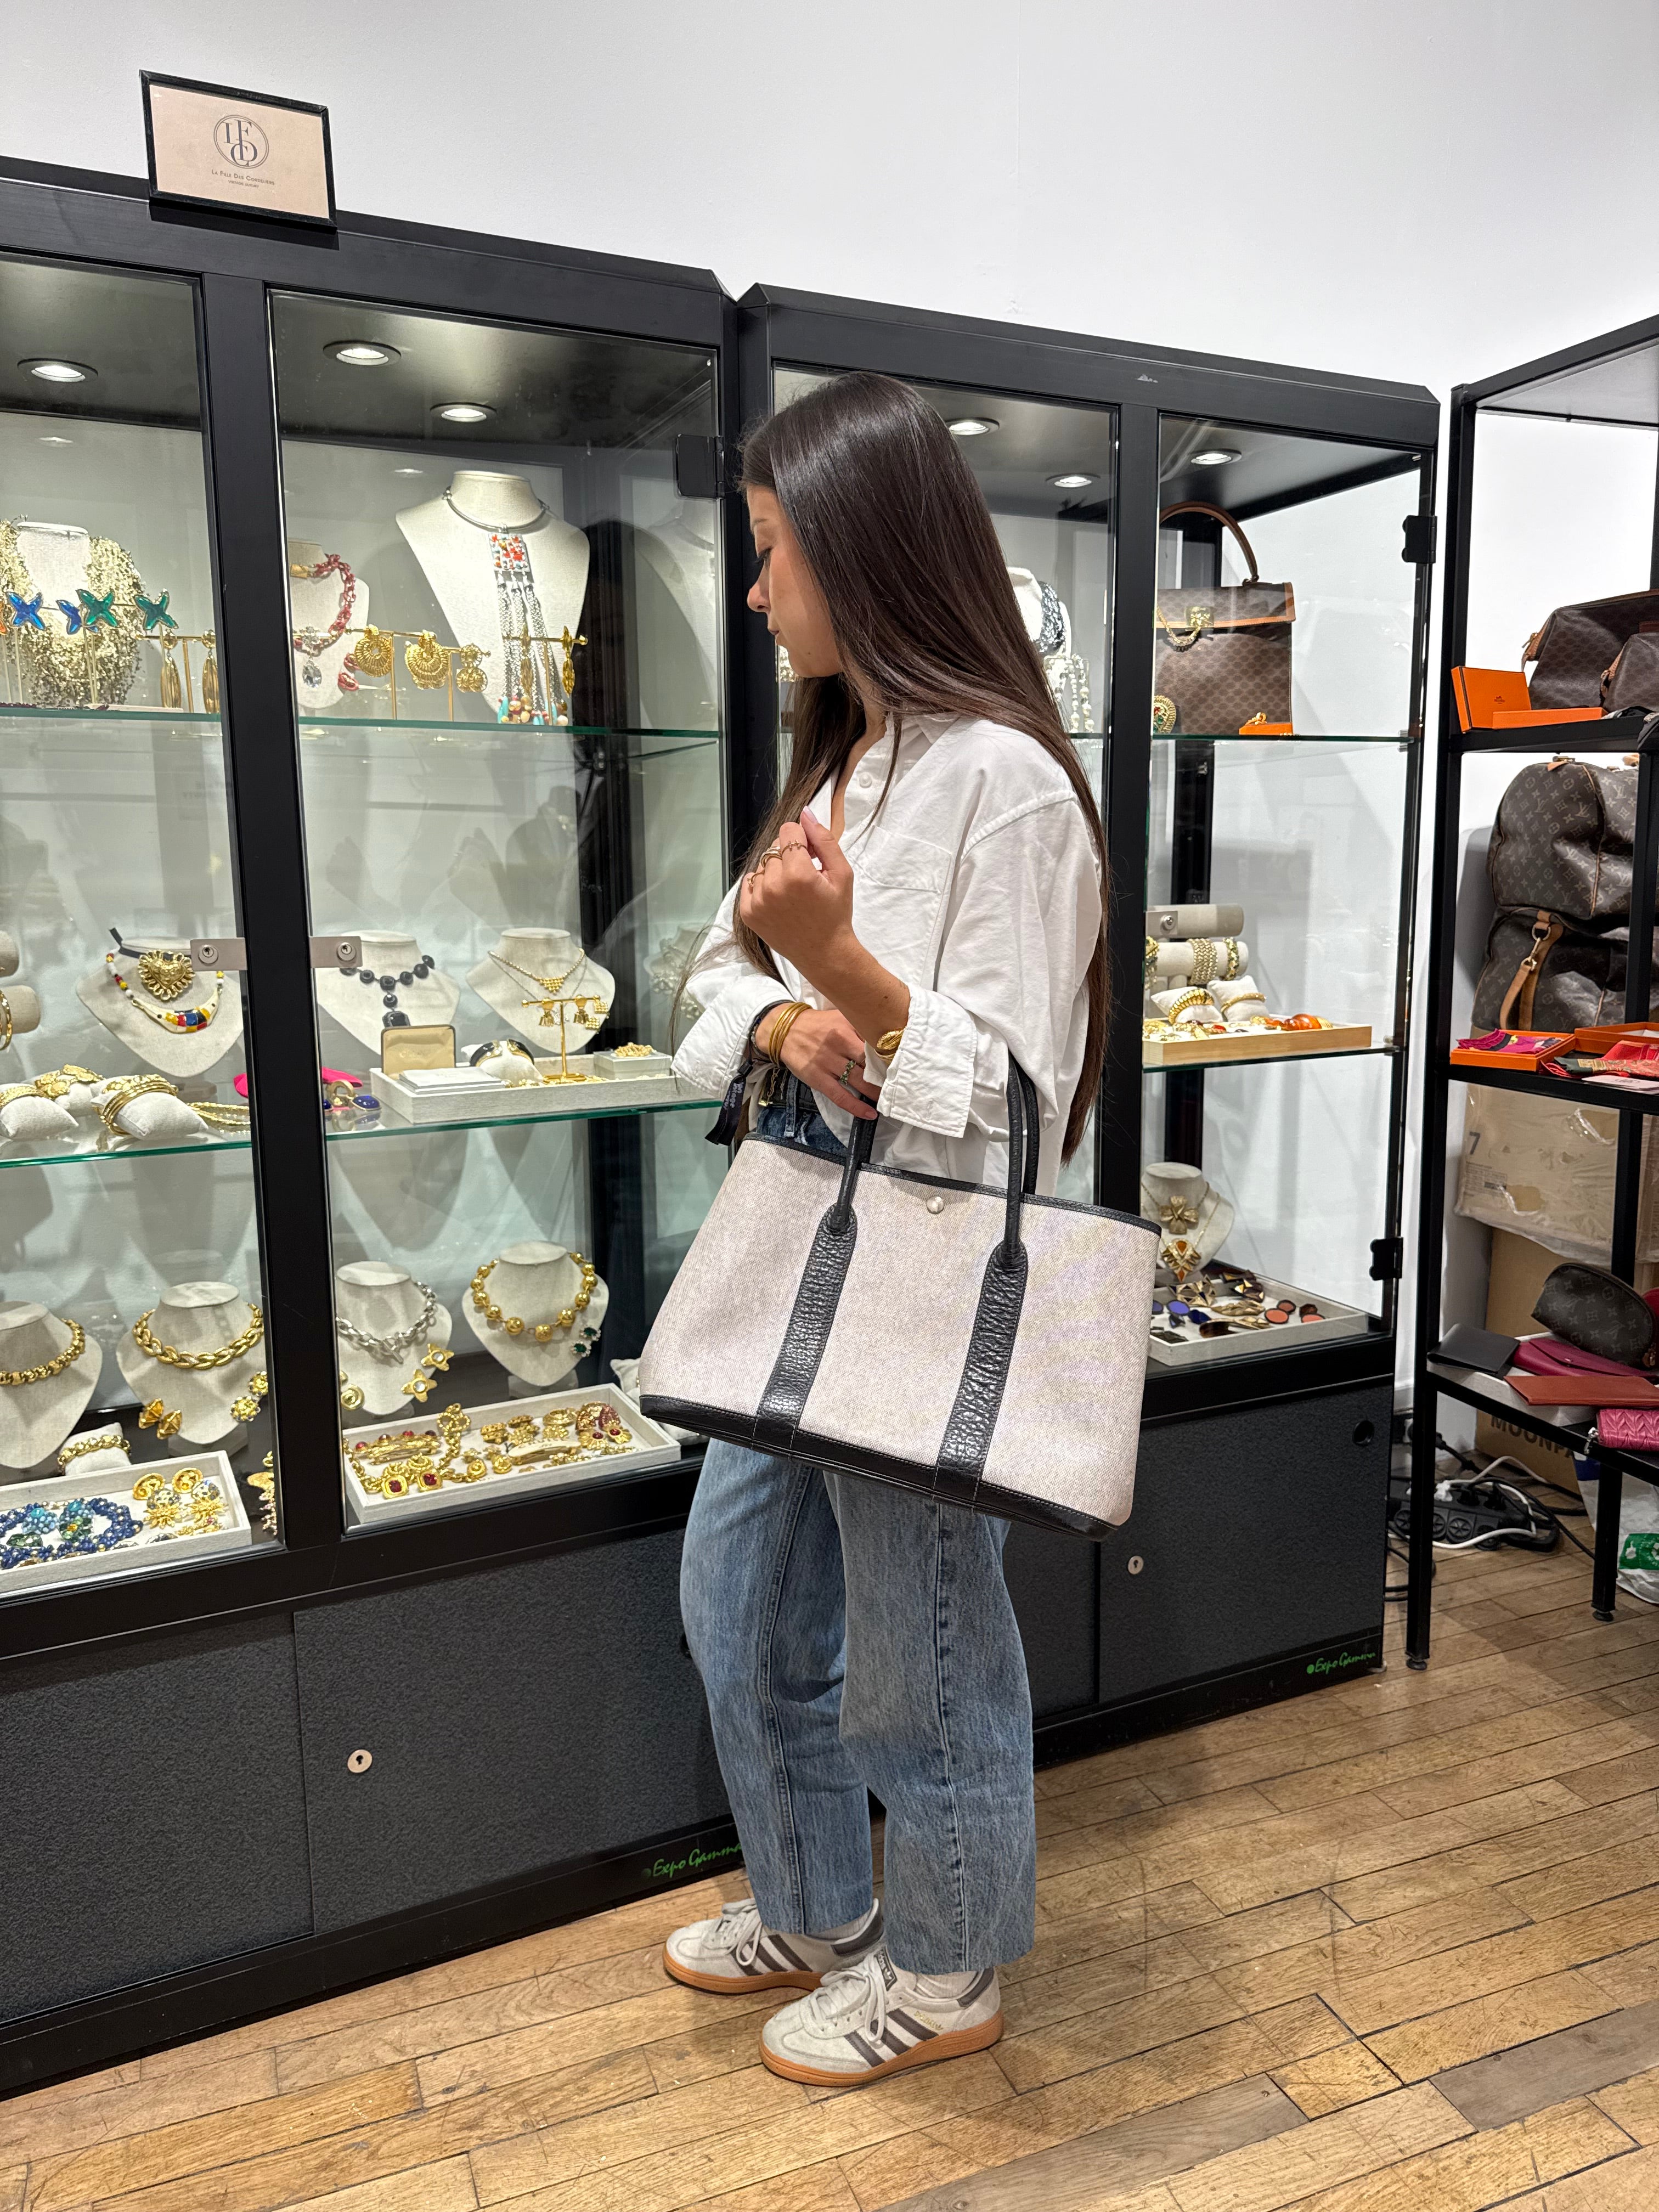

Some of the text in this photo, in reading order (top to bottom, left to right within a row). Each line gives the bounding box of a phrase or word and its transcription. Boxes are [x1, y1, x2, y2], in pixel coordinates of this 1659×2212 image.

[1469, 1131, 1481, 1155] 7
[1315, 1657, 1338, 1674] Expo
[652, 1858, 686, 1878] Expo
